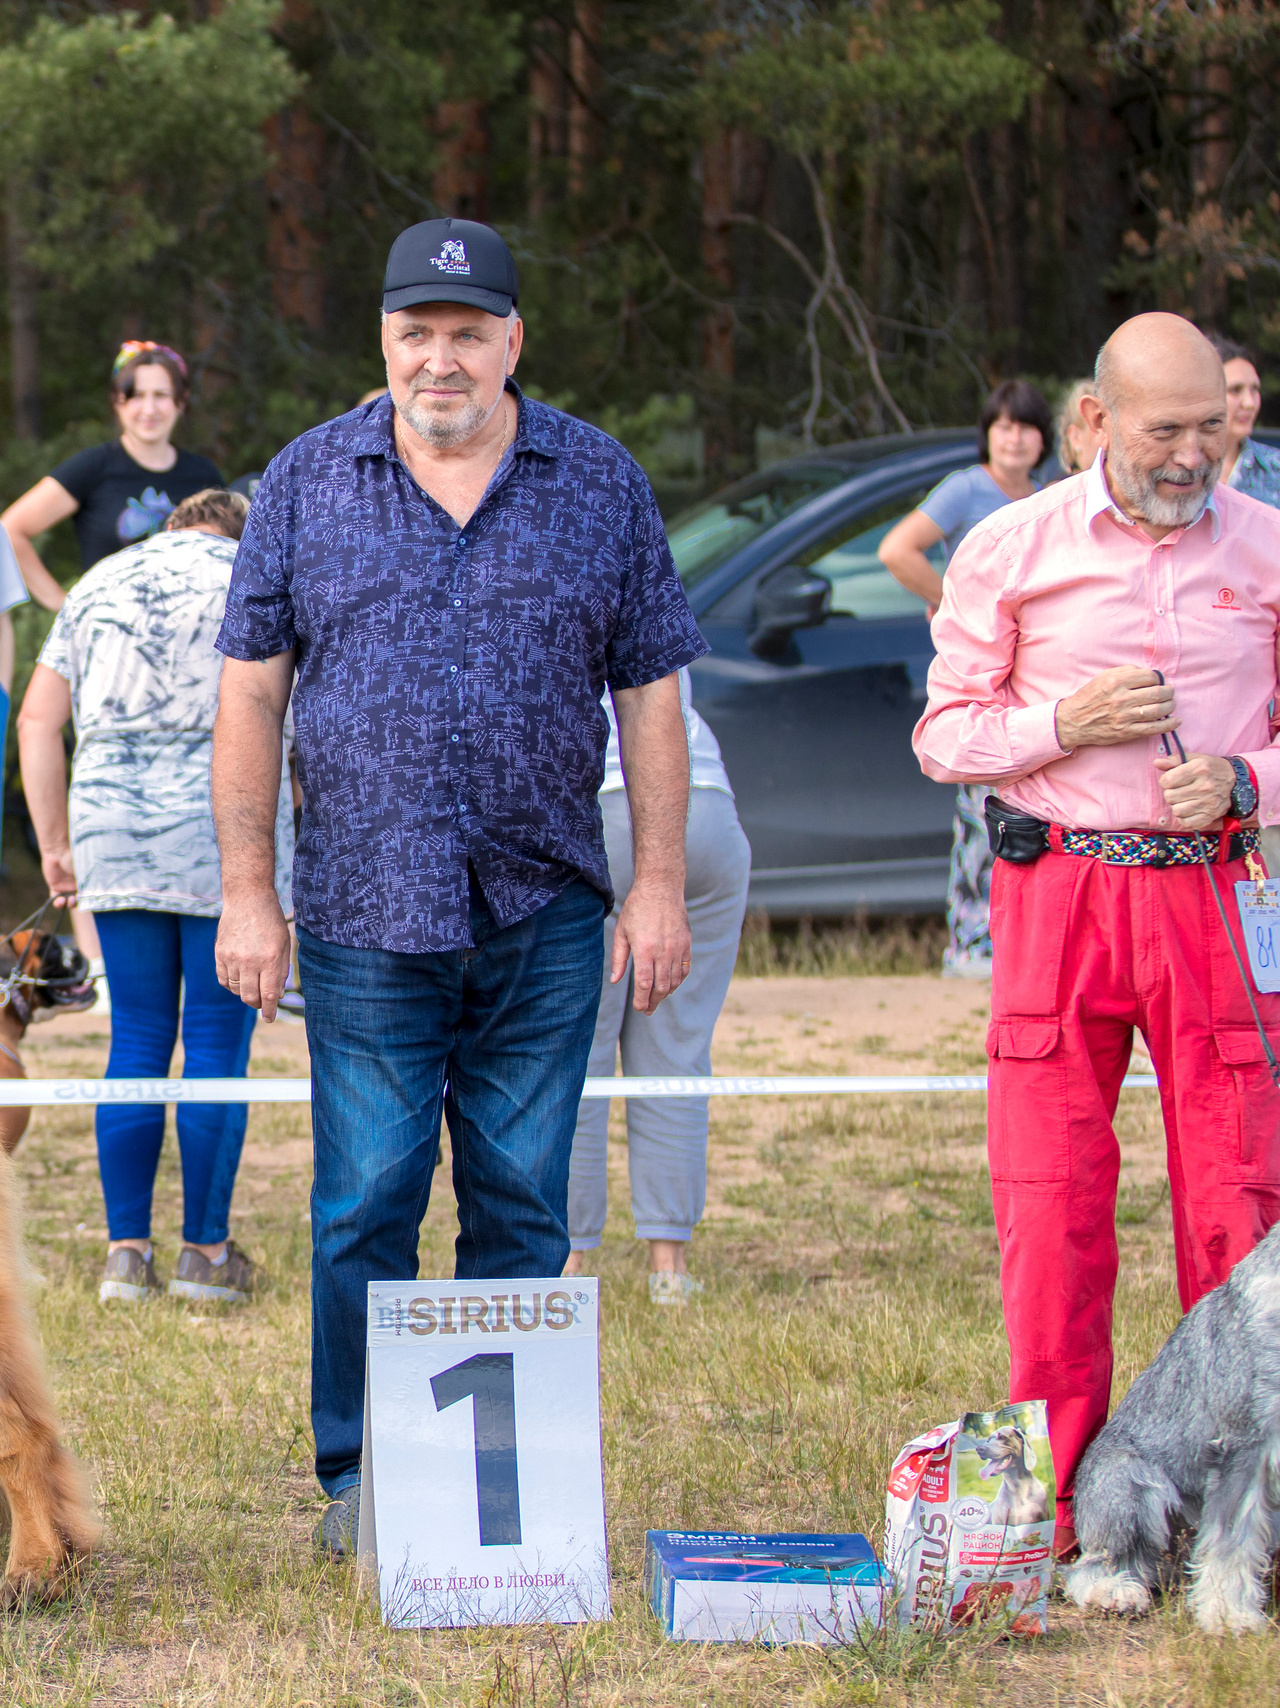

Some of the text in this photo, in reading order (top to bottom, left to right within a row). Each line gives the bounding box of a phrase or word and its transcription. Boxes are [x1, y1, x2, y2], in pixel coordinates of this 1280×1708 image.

[429, 1352, 522, 1546] 1
[922, 1473, 945, 1486] ADULT
[959, 1506, 984, 1517] 40%
[963, 1532, 1003, 1541] МЯСНОЙ
[963, 1542, 1000, 1550] РАЦИОН
[412, 1577, 443, 1592] ВСЕ
[446, 1575, 490, 1593] ДЕЛО
[494, 1576, 504, 1589] В
